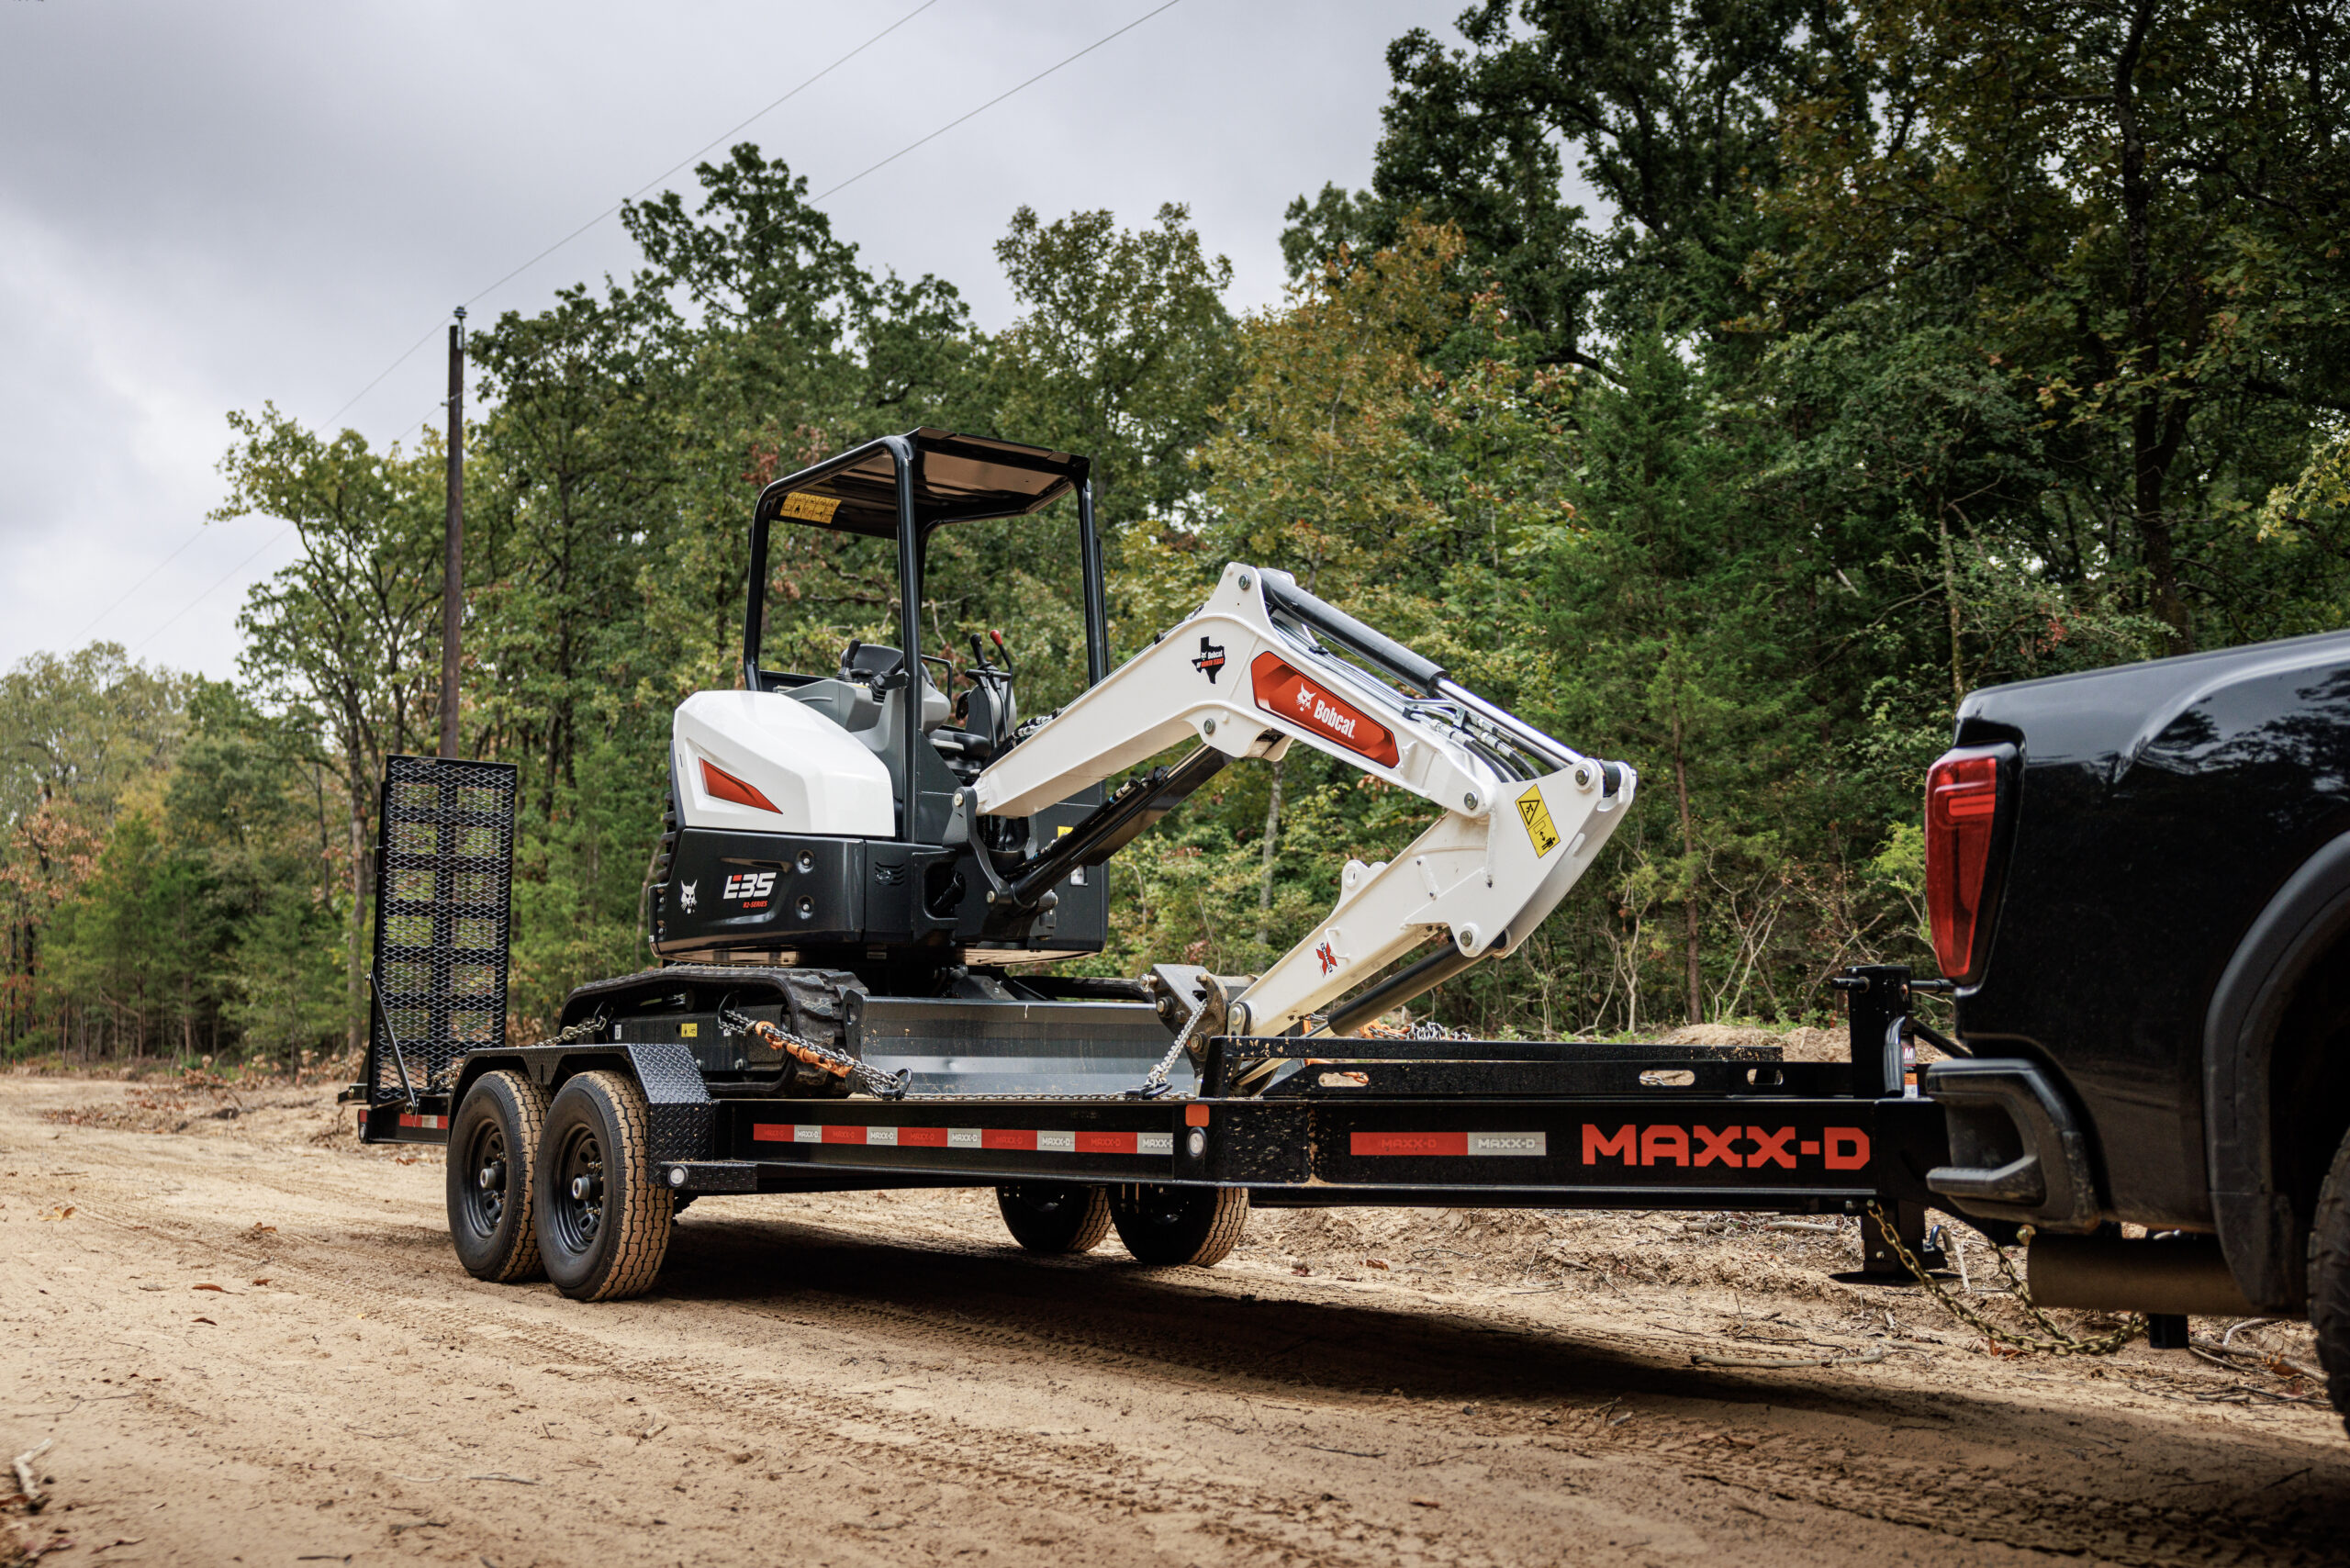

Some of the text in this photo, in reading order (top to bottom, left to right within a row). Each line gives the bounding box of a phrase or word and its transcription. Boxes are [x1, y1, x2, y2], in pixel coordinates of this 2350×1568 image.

[1314, 699, 1356, 738] Bobcat
[723, 872, 777, 900] E35
[743, 900, 768, 909] R2-SERIES
[797, 1130, 819, 1138] MAXX-D
[870, 1131, 894, 1140] MAXX-D
[952, 1133, 978, 1142] MAXX-D
[1042, 1137, 1070, 1147] MAXX-D
[1381, 1138, 1536, 1148] MAXX-D MAXX-D
[1582, 1124, 1871, 1170] MAXX-D
